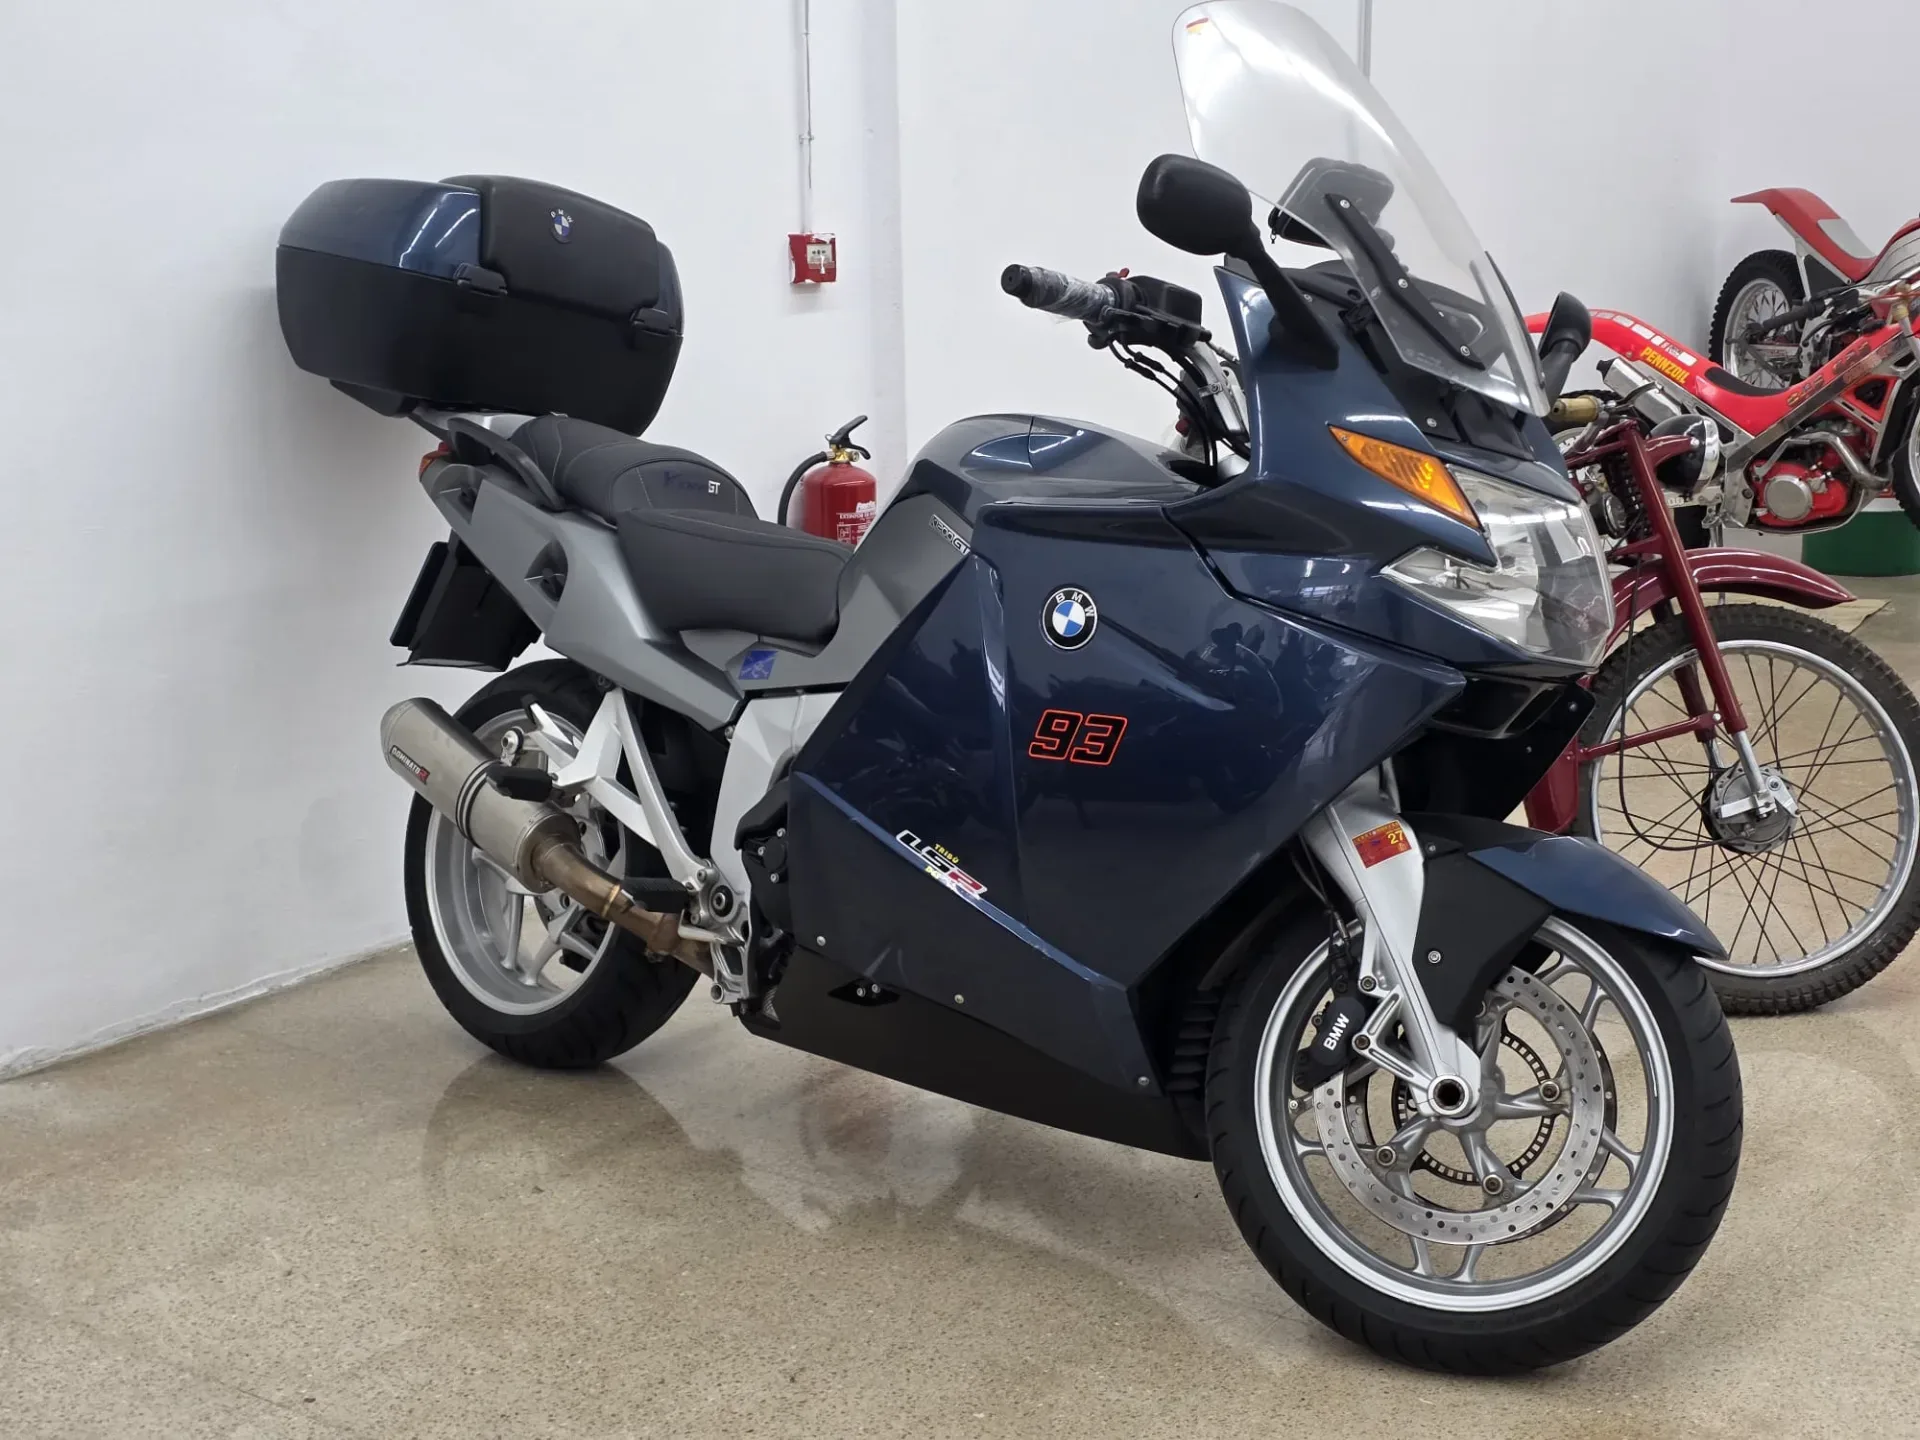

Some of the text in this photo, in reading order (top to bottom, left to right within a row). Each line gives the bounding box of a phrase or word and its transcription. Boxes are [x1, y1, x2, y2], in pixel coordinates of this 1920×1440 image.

[550, 208, 573, 223] BMW
[1640, 346, 1690, 384] PENNZOIL
[1055, 591, 1095, 617] BMW
[1028, 709, 1128, 766] 93
[391, 746, 429, 783] DOMINATOR
[1387, 829, 1404, 845] 27
[1323, 1012, 1350, 1051] BMW
